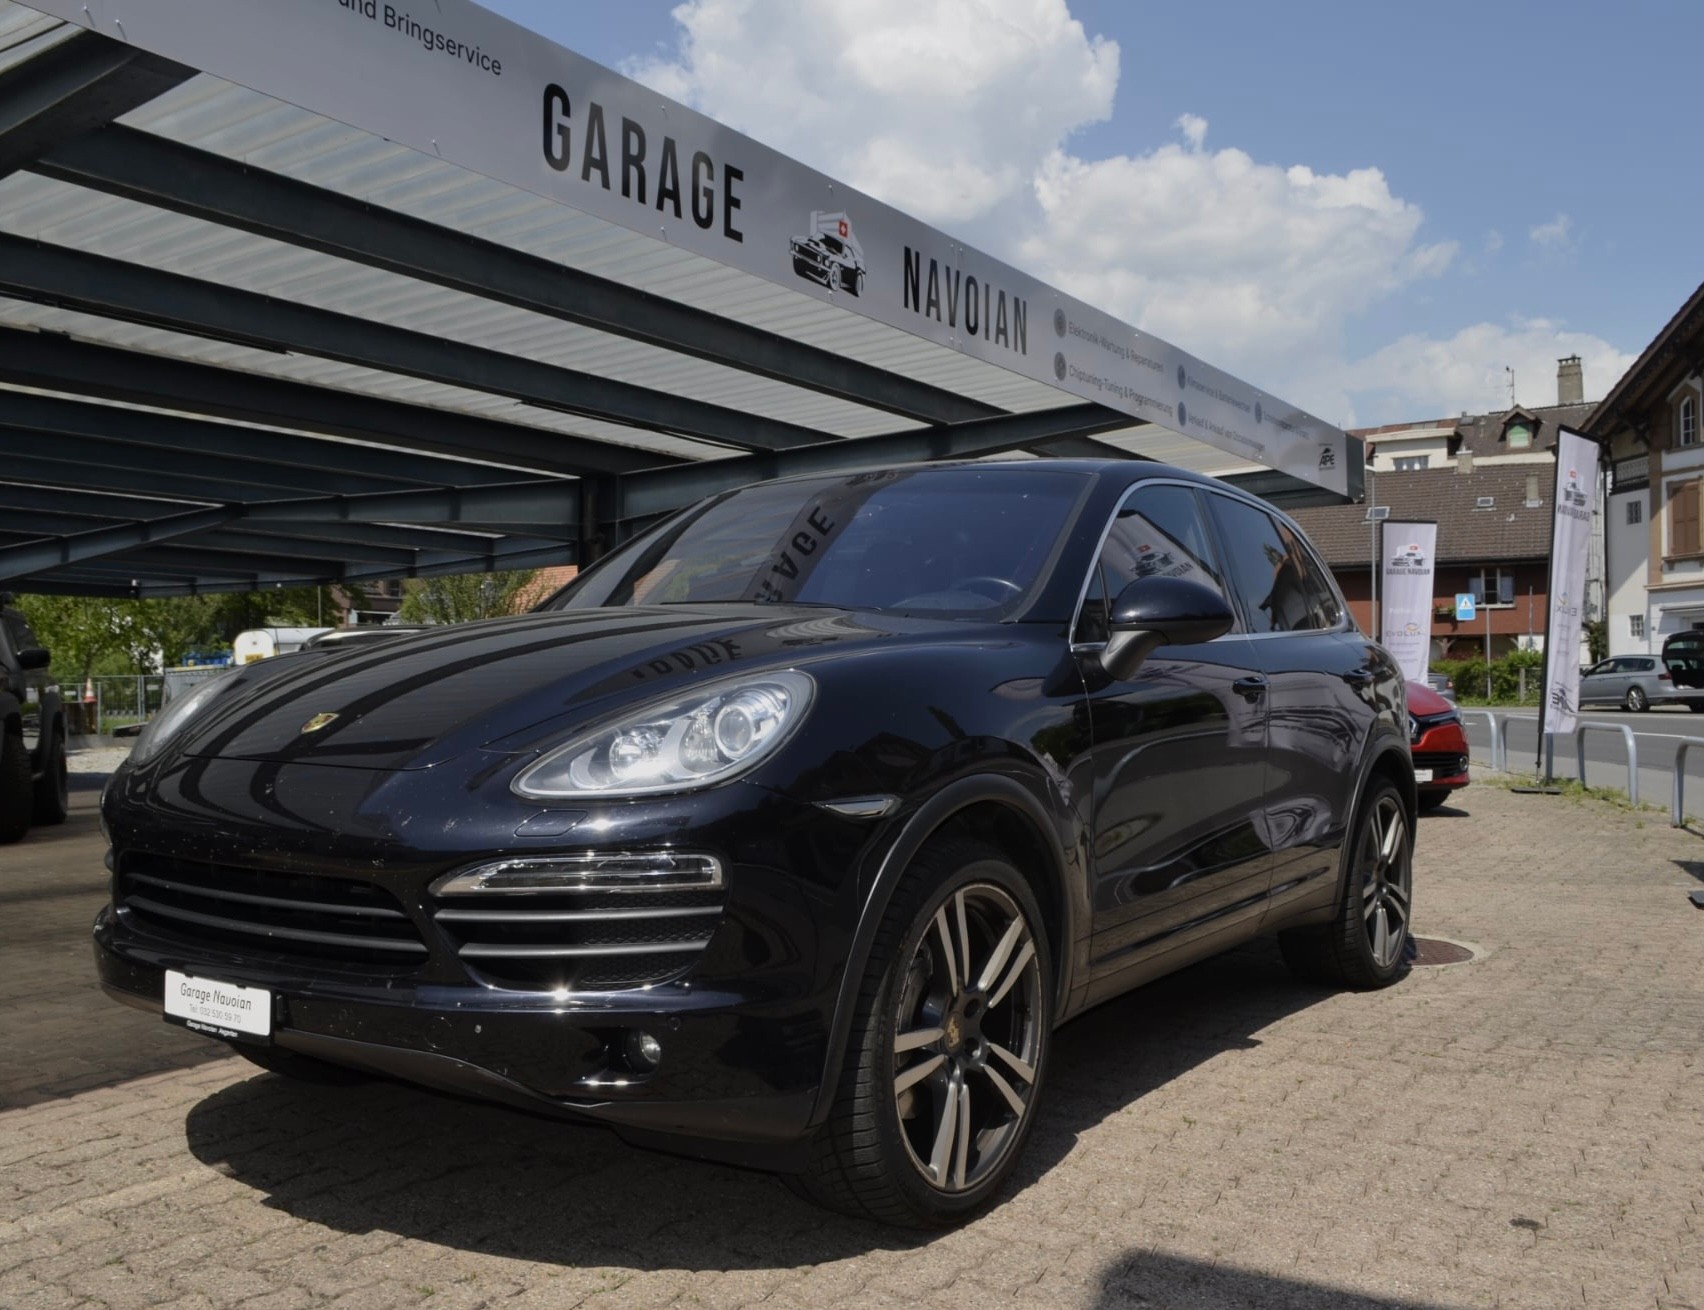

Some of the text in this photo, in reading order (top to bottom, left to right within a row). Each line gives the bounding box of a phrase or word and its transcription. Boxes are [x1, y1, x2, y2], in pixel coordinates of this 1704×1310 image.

[384, 5, 502, 76] Bringservice
[542, 83, 1028, 356] GARAGE NAVOIAN
[181, 983, 252, 1010] Garage Navoian
